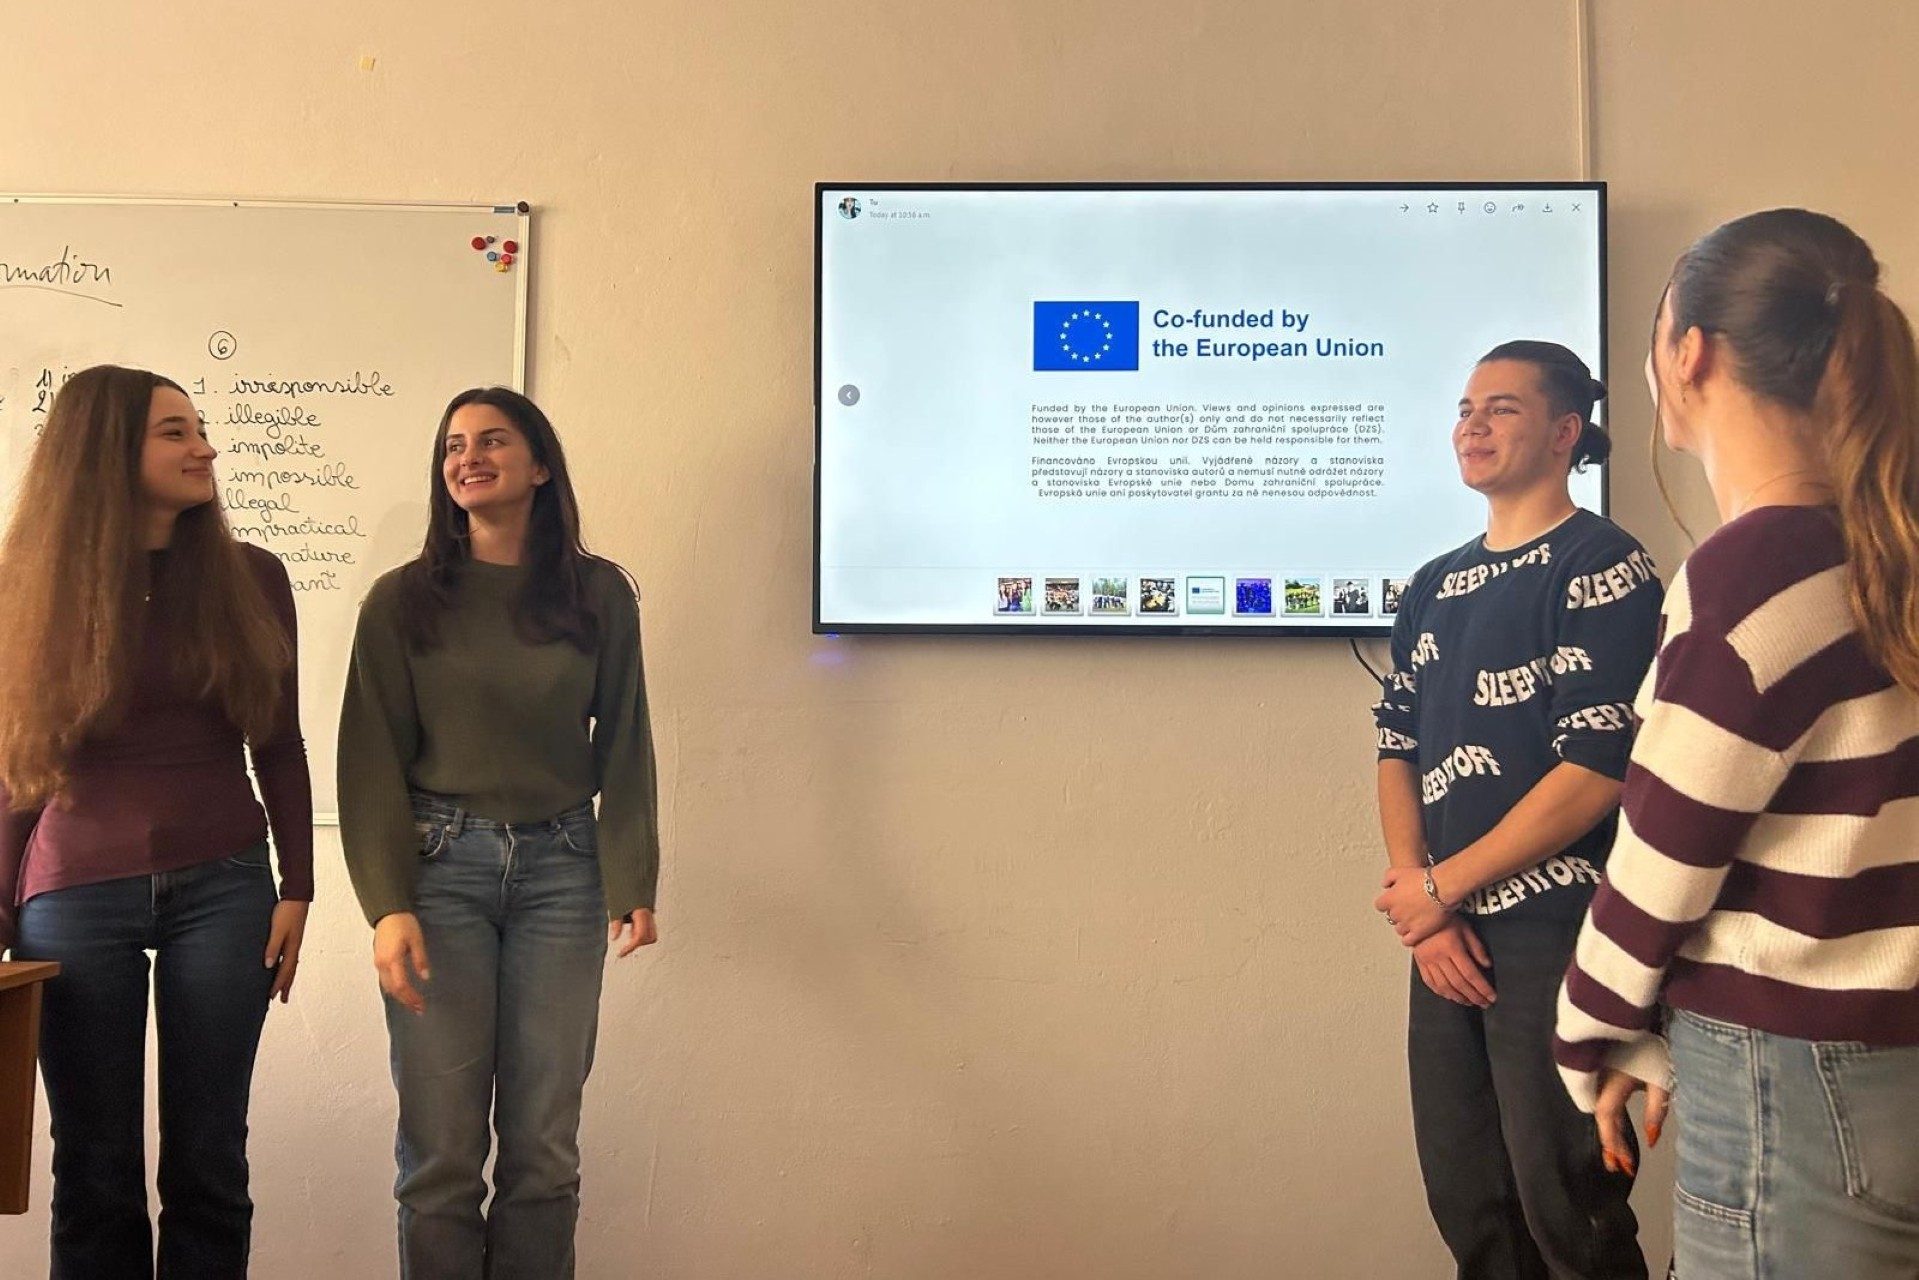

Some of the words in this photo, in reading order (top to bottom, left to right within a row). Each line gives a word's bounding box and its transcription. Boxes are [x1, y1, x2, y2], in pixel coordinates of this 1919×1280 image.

[869, 211, 888, 219] Today
[0, 245, 111, 285] rmation
[1153, 309, 1274, 329] Co-funded
[1282, 309, 1310, 332] by
[1152, 338, 1188, 357] the
[1197, 339, 1308, 361] European
[1317, 338, 1384, 357] Union
[229, 371, 395, 398] irresponsible
[224, 403, 321, 439] illegible
[1031, 404, 1069, 412] Funded
[1073, 404, 1086, 414] by
[1091, 404, 1108, 412] the
[1113, 404, 1161, 414] European
[1166, 404, 1197, 412] Union.
[1202, 403, 1231, 412] Views
[1236, 403, 1256, 412] and
[1262, 403, 1305, 414] opinions
[1310, 403, 1362, 414] expressed
[1031, 414, 1074, 423] however
[1078, 414, 1107, 423] those
[1111, 414, 1121, 423] of
[1125, 414, 1142, 423] the
[1147, 413, 1194, 425] author(s)
[1199, 414, 1220, 425] only
[1225, 414, 1245, 423] and
[1250, 414, 1263, 423] do
[1268, 414, 1285, 423] not
[1289, 414, 1347, 425] necessarily
[1352, 414, 1385, 423] reflect
[1031, 425, 1060, 434] those
[1064, 425, 1075, 434] of
[1079, 425, 1097, 434] the
[1101, 425, 1149, 435] European
[1154, 425, 1183, 434] Union
[1204, 424, 1228, 433] Dům
[1233, 424, 1286, 433] zahraniční
[1291, 424, 1349, 435] spolupráce
[1354, 424, 1385, 435] (DZS).
[1033, 436, 1069, 445] Neither
[1072, 436, 1088, 445] the
[1091, 436, 1138, 446] European
[1141, 436, 1170, 445] Union
[1192, 436, 1210, 445] DZS
[1234, 435, 1248, 444] be
[1250, 435, 1272, 444] held
[1275, 435, 1333, 446] responsible
[1336, 435, 1350, 444] for
[1353, 435, 1382, 444] them.
[228, 434, 325, 461] impolite
[1031, 456, 1096, 465] Financováno
[1107, 456, 1158, 467] Evropskou
[1202, 455, 1253, 466] Vyjádřené
[1265, 456, 1299, 466] názory
[1310, 457, 1318, 465] a
[1329, 456, 1385, 465] stanoviska
[1031, 467, 1088, 477] představují
[1090, 467, 1123, 477] názory
[1135, 467, 1189, 476] stanoviska
[1191, 466, 1225, 476] autorů
[1237, 466, 1275, 475] nemusí
[1276, 466, 1306, 475] nutně
[1308, 466, 1348, 475] odrážet
[1350, 466, 1385, 477] názory
[228, 462, 361, 490] impossible
[1031, 479, 1039, 487] a
[1046, 478, 1100, 487] stanoviska
[1108, 478, 1152, 489] Evropské
[1160, 478, 1182, 487] unie
[1190, 478, 1217, 487] nebo
[1224, 477, 1254, 486] Domu
[1262, 477, 1316, 486] zahraniční
[1324, 477, 1385, 488] spolupráce.
[222, 487, 300, 523] llegal
[1038, 488, 1083, 499] Evropská
[1085, 489, 1107, 498] unie
[1109, 489, 1126, 498] ani
[1127, 488, 1193, 499] poskytovatel
[1194, 488, 1229, 499] grantu
[1231, 489, 1244, 498] za
[1246, 489, 1259, 498] ně
[1261, 489, 1306, 498] nenesou
[1307, 488, 1378, 499] odpovědnost.
[230, 515, 367, 543] mpractical
[291, 570, 341, 592] ant
[1435, 564, 1489, 600] SLEEP
[1567, 562, 1637, 610] SLEEP
[1473, 666, 1536, 707] SLEEP
[1551, 645, 1593, 675] OFF
[1453, 744, 1501, 777] OFF
[1519, 864, 1552, 894] IT
[1546, 855, 1602, 887] OFF
